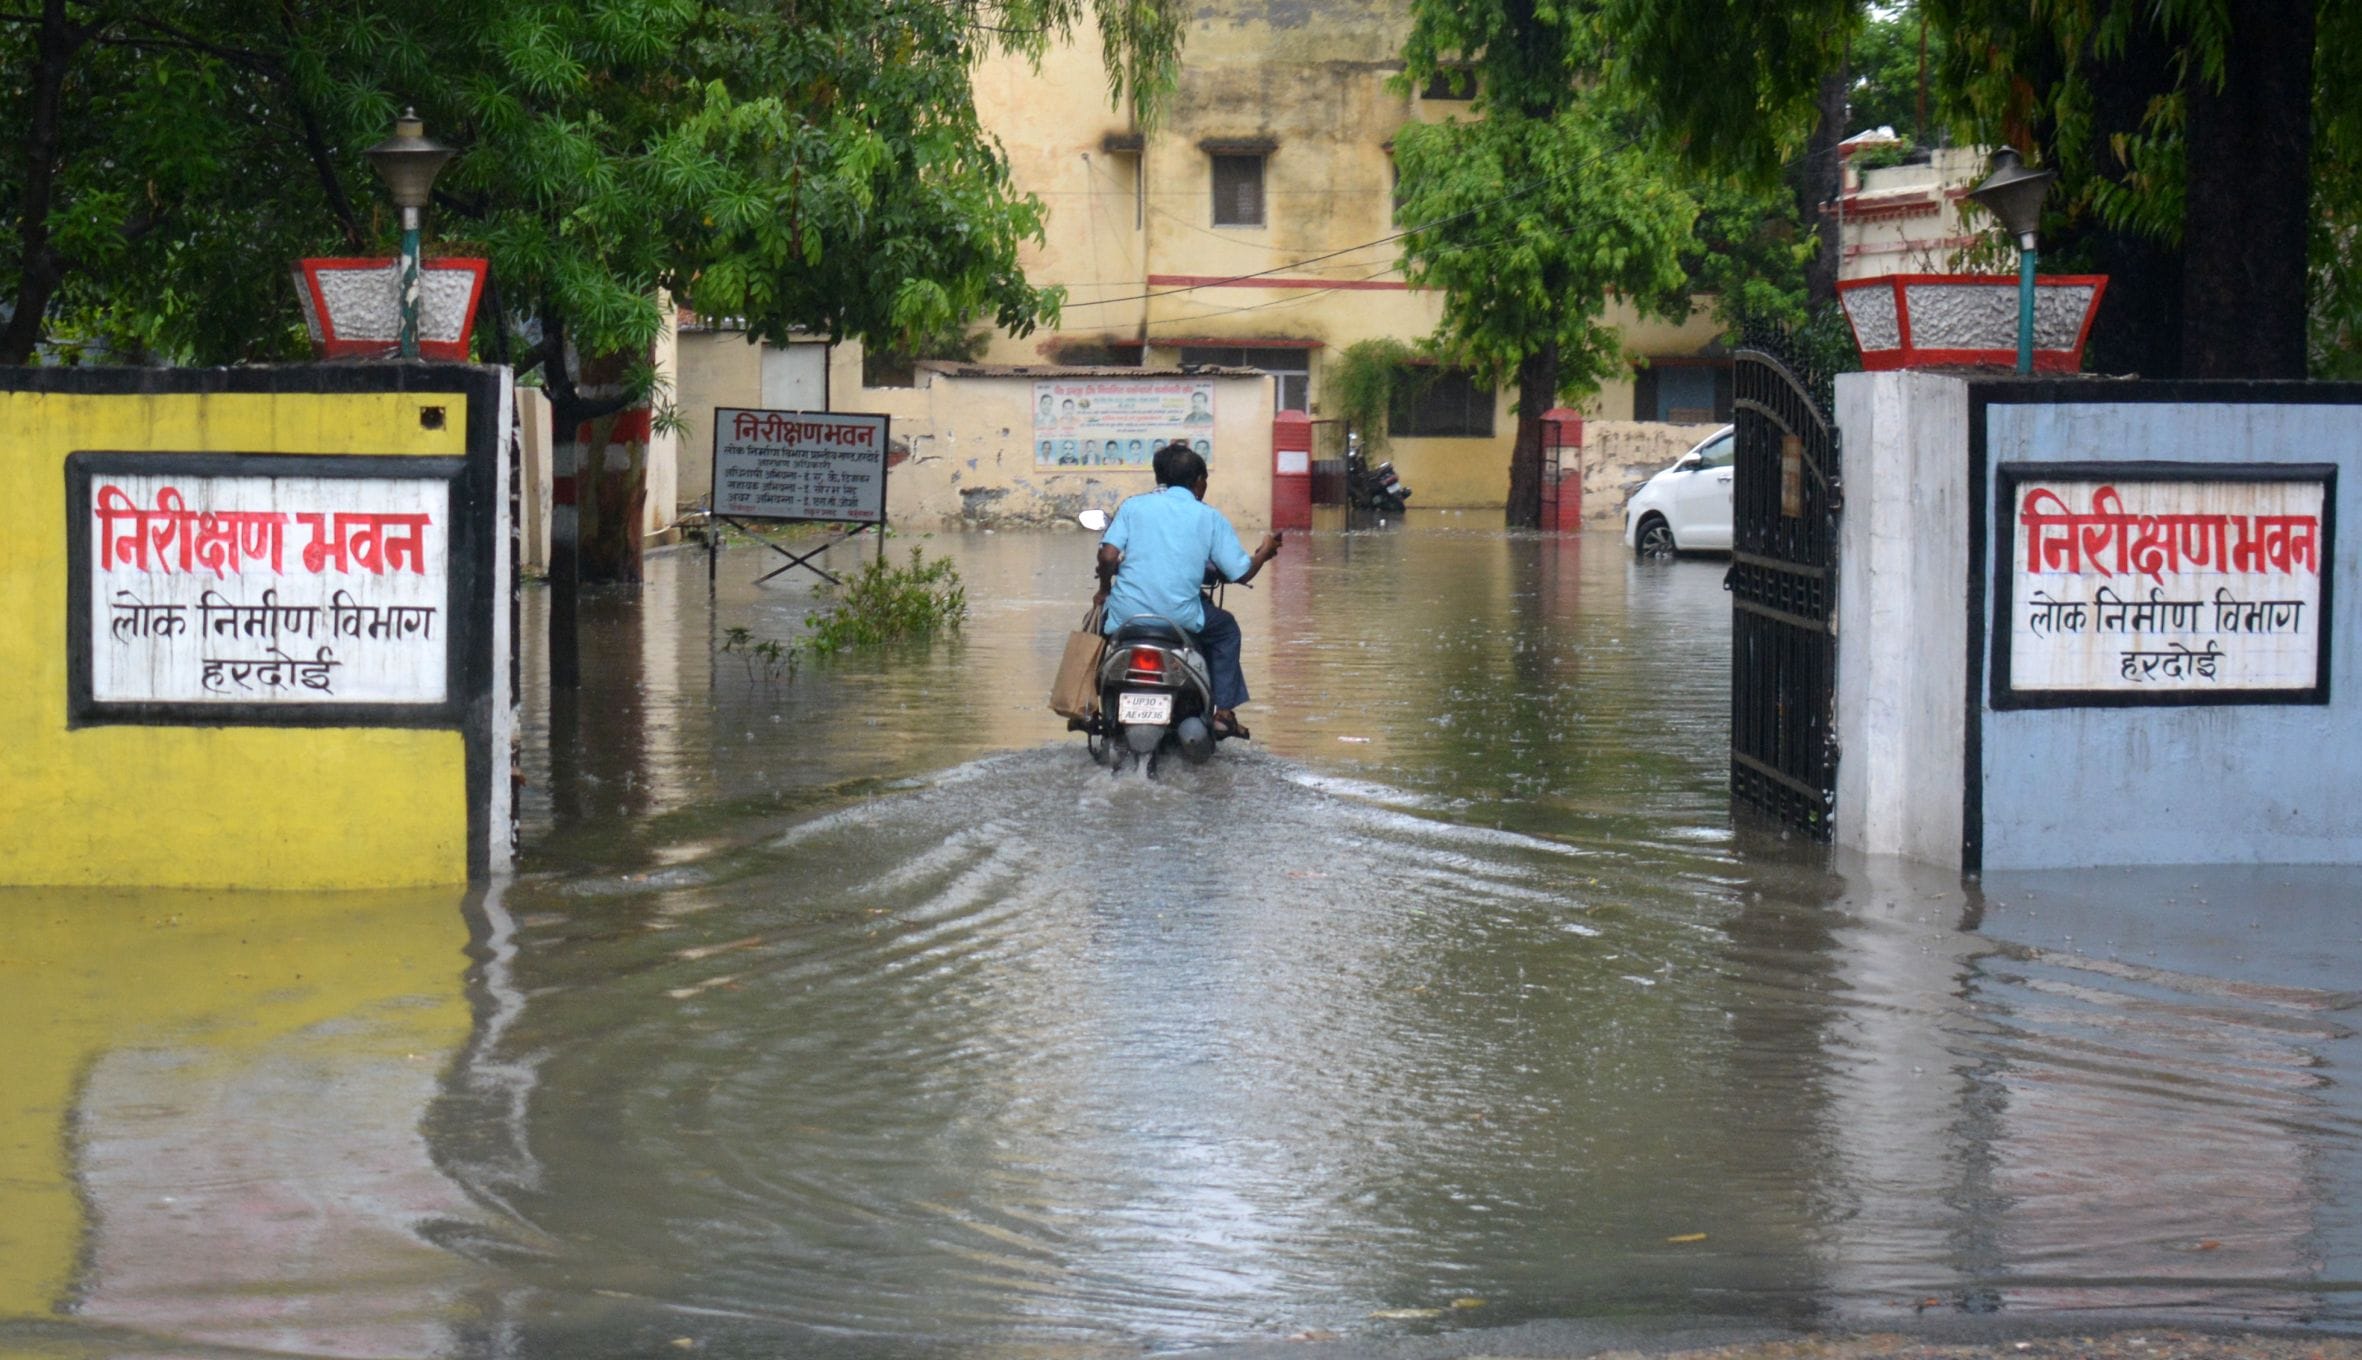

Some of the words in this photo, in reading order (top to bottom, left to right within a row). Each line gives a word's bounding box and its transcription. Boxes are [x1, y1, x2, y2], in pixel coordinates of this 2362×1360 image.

[733, 412, 823, 447] निरीक्षण
[824, 423, 876, 447] भवन
[95, 485, 289, 580] निरीक्षण
[296, 512, 432, 575] भवन
[2020, 486, 2228, 585] निरीक्षण
[2229, 514, 2319, 575] भवन
[112, 590, 187, 645] लोक
[196, 589, 322, 640] निर्माण
[329, 589, 436, 640] विभाग
[2029, 590, 2087, 639] लोक
[2093, 586, 2204, 634] निर्माण
[2213, 587, 2306, 634] विभाग
[201, 646, 342, 695] हरदोई
[2120, 639, 2225, 682] हरदोई
